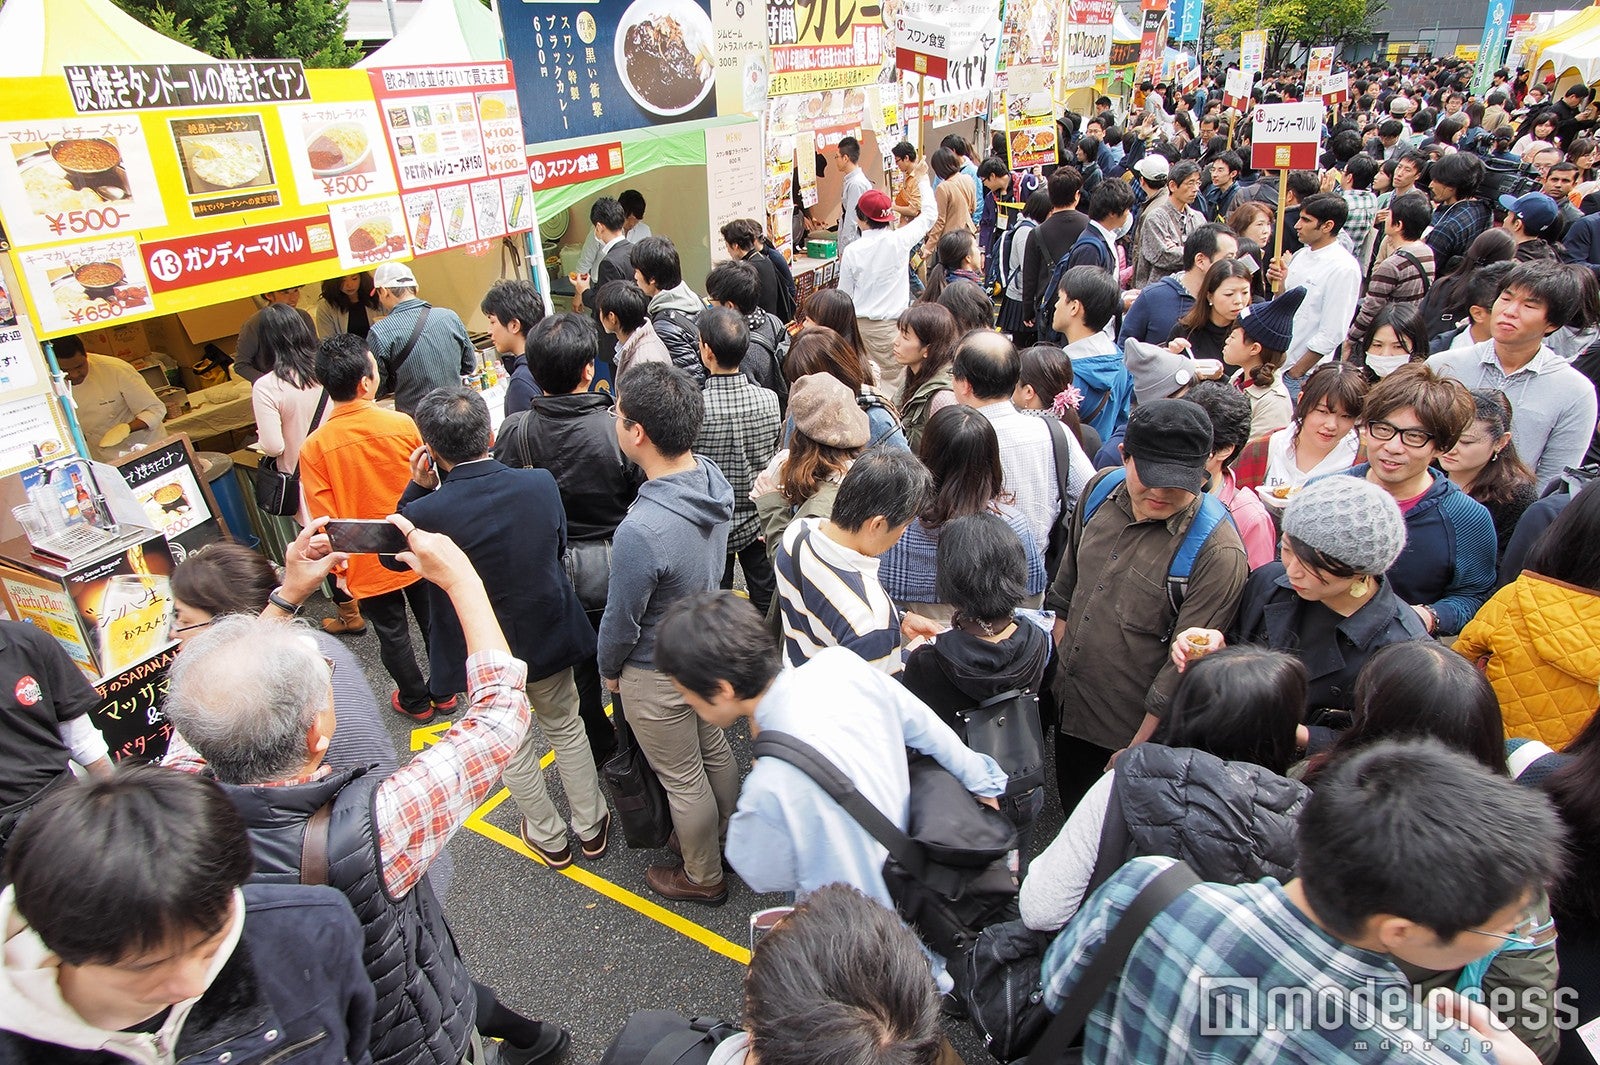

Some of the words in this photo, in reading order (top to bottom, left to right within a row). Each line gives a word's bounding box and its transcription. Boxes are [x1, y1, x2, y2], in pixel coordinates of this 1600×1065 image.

[717, 29, 743, 39] ジムビーム
[906, 28, 946, 49] スワン食堂
[533, 15, 549, 78] 600円
[718, 41, 764, 52] シトラスハイボール
[560, 15, 581, 101] スワン特製
[719, 56, 738, 68] 300円
[384, 68, 505, 90] 飲み物は並ばないで買えます
[545, 14, 569, 130] ブラックカレー
[584, 47, 604, 118] 黒い衝撃
[68, 60, 306, 111] 炭焼きタンドールの焼きたてナン
[301, 108, 368, 122] キーマカレーライス
[1265, 115, 1317, 133] ガンディーマハル
[546, 152, 600, 179] スワン食堂
[26, 241, 135, 265] キーマカレーとチーズナン
[152, 252, 181, 277] 13
[185, 231, 304, 272] ガンディーマハル
[470, 241, 490, 254] コチラ
[146, 705, 165, 726] &
